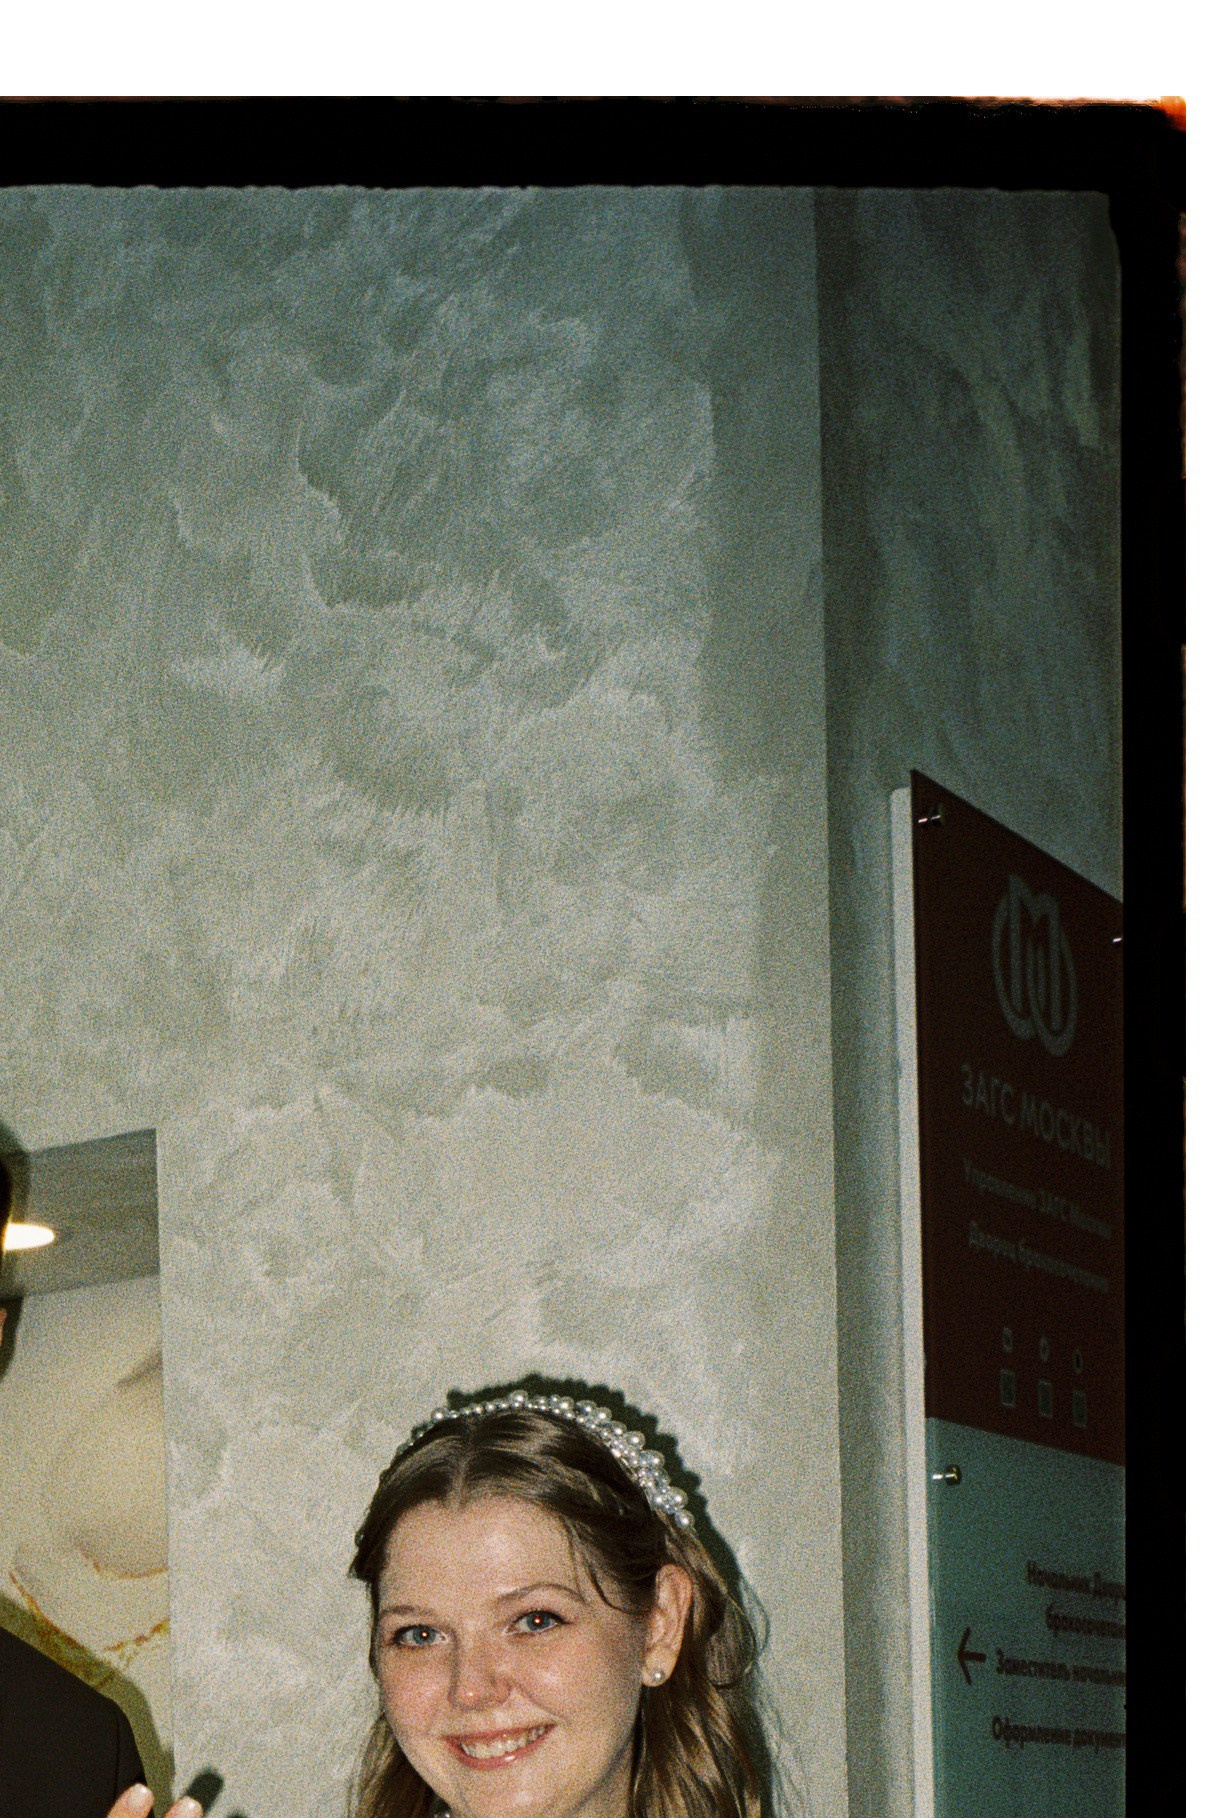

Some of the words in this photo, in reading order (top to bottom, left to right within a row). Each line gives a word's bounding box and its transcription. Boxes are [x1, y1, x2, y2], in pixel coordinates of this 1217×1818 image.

[961, 1063, 1015, 1125] ЗАГС
[1019, 1091, 1111, 1169] МОСКВЫ
[963, 1157, 1036, 1209] Управление
[1038, 1188, 1068, 1222] ЗАГС
[969, 1220, 1017, 1263] Дворец
[996, 1648, 1071, 1682] Заместитель
[992, 1715, 1071, 1749] Оформление
